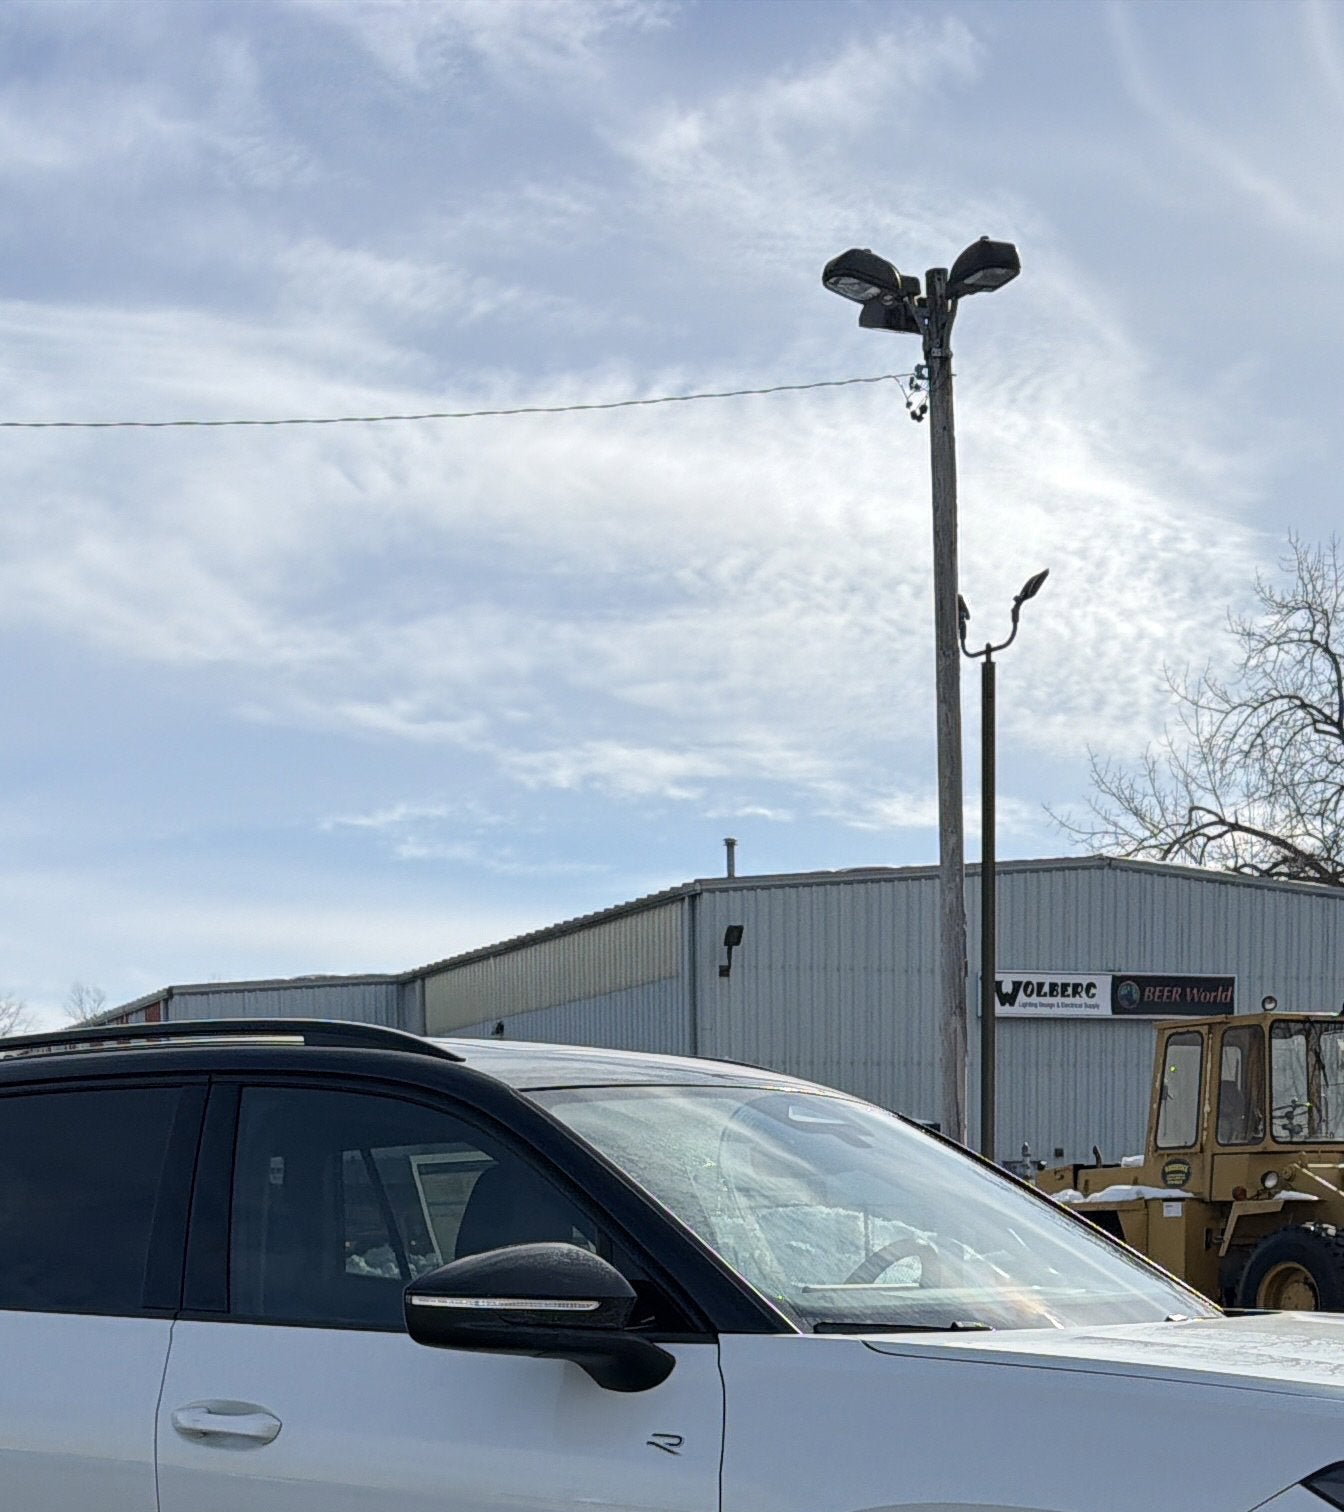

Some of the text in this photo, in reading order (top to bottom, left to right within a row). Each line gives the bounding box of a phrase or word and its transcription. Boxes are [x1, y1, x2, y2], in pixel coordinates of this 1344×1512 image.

[995, 980, 1097, 1006] WOLBERG
[1144, 986, 1233, 1003] BEER World
[1019, 1001, 1038, 1009] Lighting
[1038, 1001, 1055, 1010] Design
[1084, 1002, 1100, 1010] Supply
